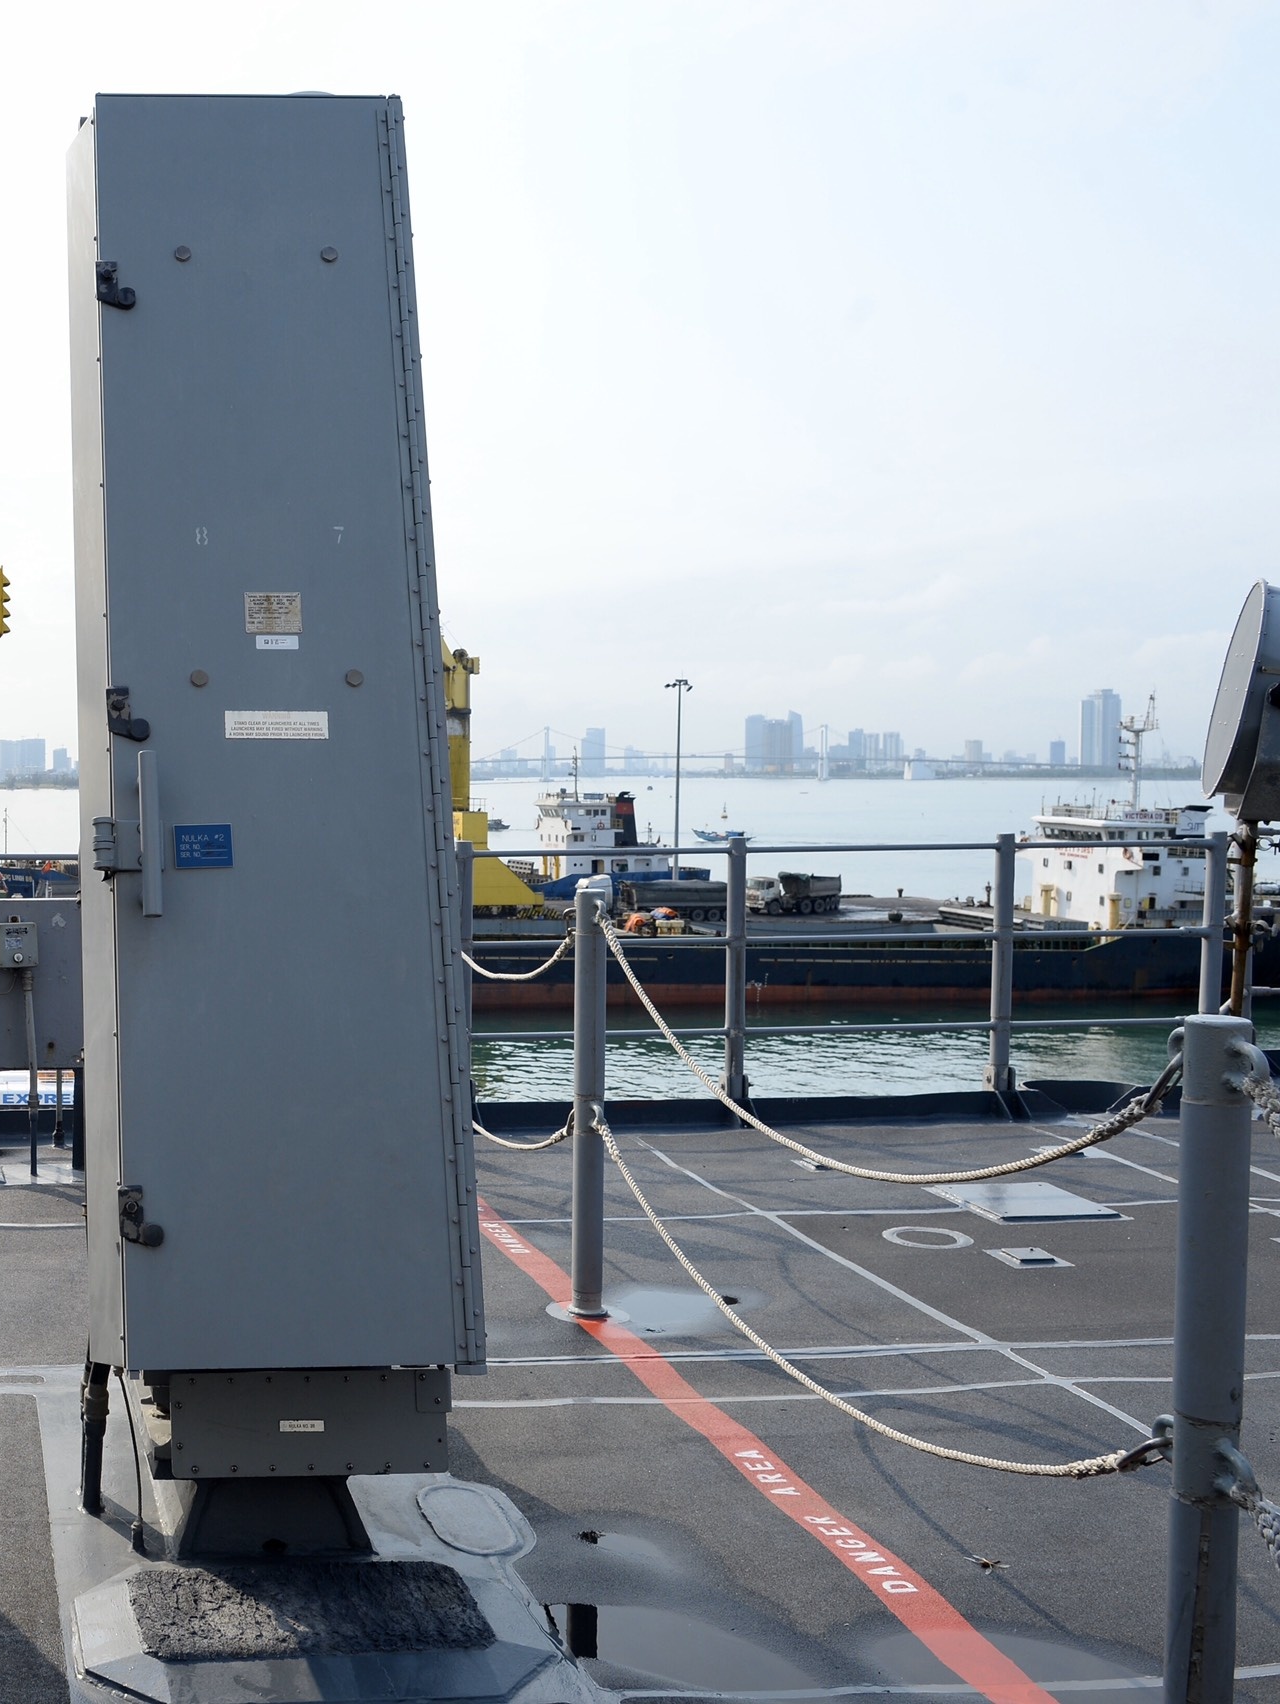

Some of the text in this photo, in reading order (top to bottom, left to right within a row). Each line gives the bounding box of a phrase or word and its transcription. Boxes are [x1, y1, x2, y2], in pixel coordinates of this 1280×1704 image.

[195, 527, 209, 545] 8
[333, 526, 344, 544] 7
[1124, 812, 1153, 820] VICTORIA
[181, 833, 224, 842] NULKA #2
[2, 1093, 74, 1104] EXRE
[482, 1222, 532, 1254] DANGER
[735, 1449, 919, 1595] DANGER AREA
